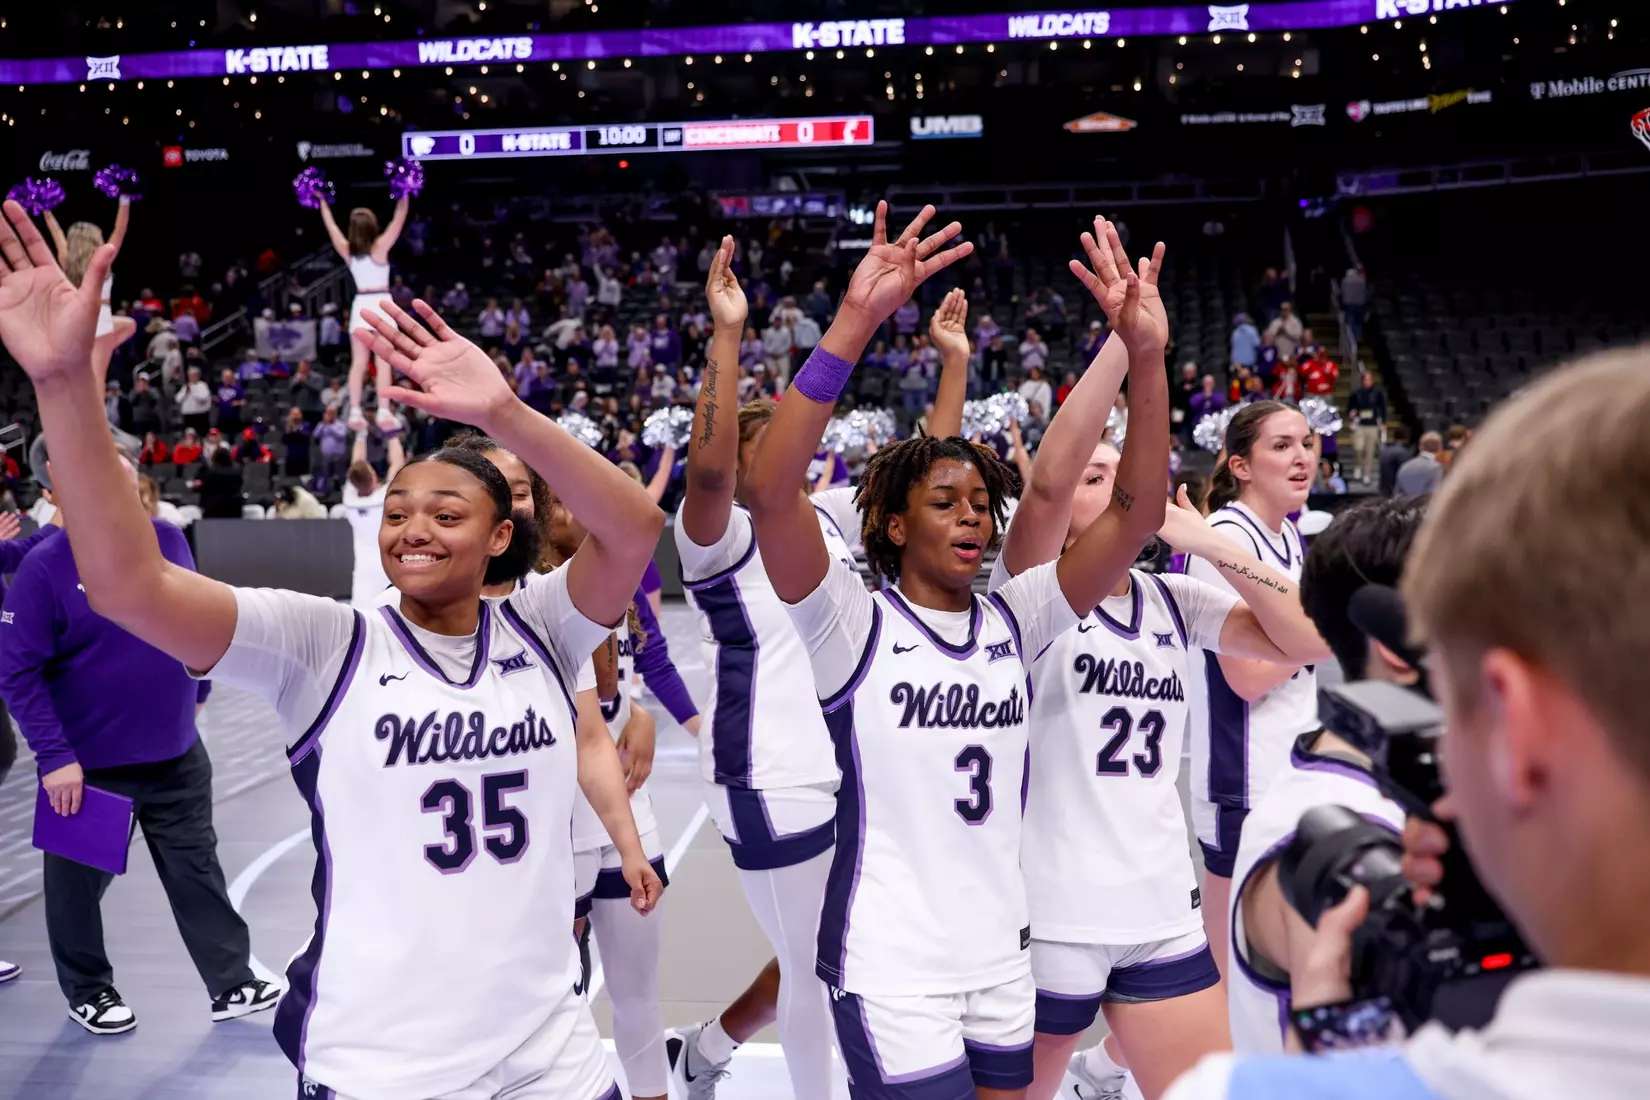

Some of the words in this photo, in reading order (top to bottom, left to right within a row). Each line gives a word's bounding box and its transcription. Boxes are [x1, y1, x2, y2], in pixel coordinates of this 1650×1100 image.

[792, 18, 905, 48] K-STATE
[1008, 11, 1110, 38] WILDCATS
[225, 45, 329, 74] K-STATE
[418, 36, 533, 63] WILDCATS
[1547, 76, 1605, 98] Mobile
[1607, 73, 1650, 92] CENT
[459, 133, 475, 155] 0
[502, 132, 571, 151] K-STATE
[797, 121, 814, 143] 0
[910, 115, 983, 135] UMB
[1074, 653, 1185, 702] Wildcats
[890, 681, 1024, 729] Wildcats
[374, 703, 557, 768] Wildcats
[1096, 705, 1167, 778] 23
[954, 744, 993, 826] 3
[419, 768, 530, 875] 35
